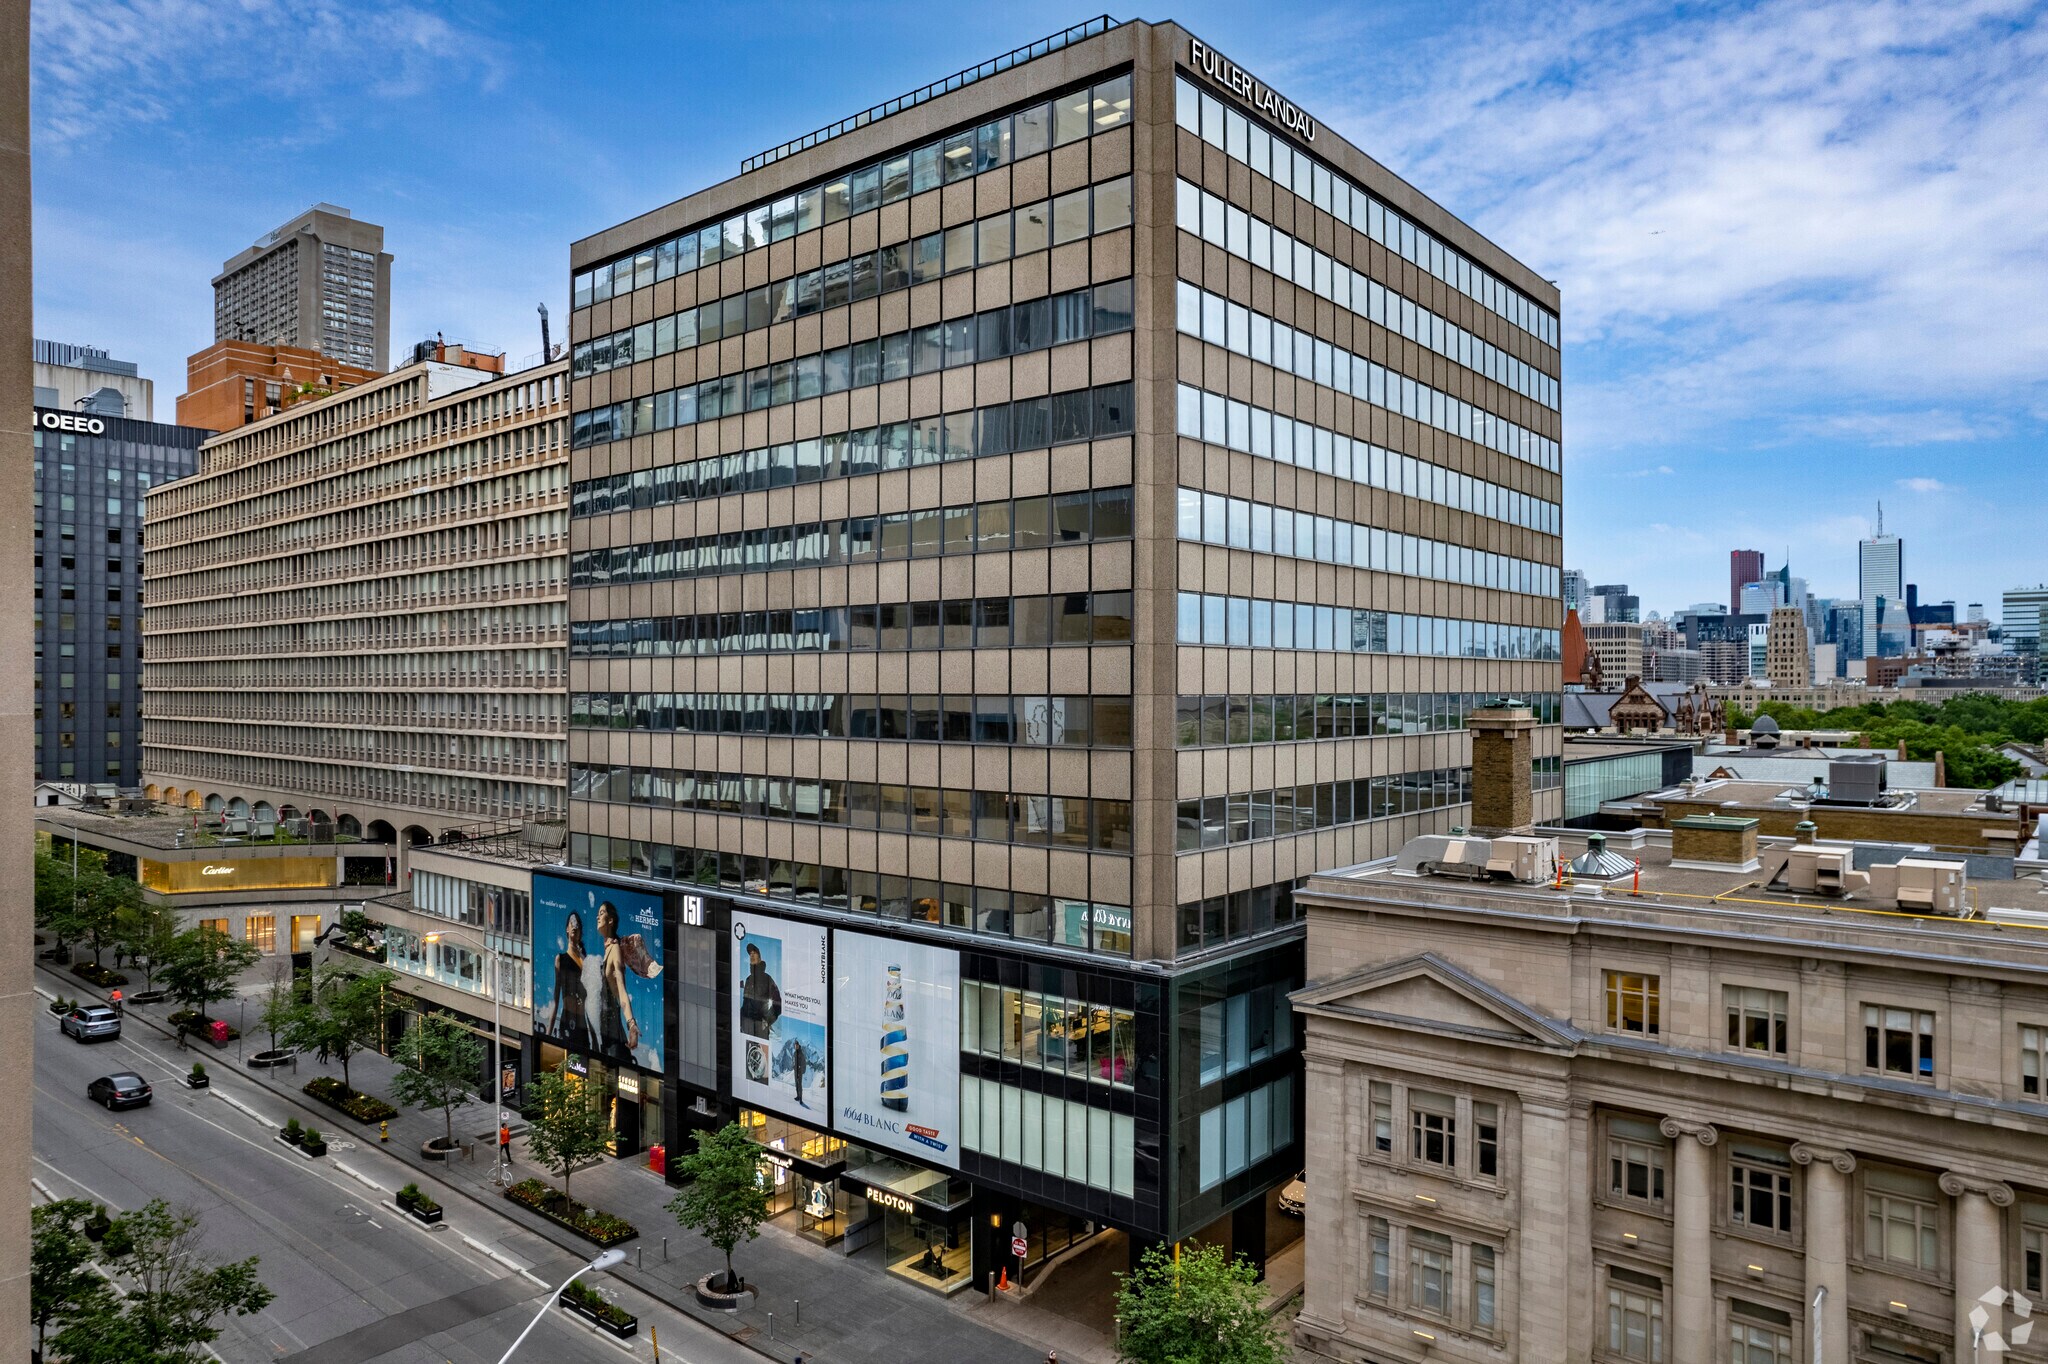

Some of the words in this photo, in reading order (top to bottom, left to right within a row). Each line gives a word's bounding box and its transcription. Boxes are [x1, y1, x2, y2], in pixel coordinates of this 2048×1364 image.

[1190, 38, 1252, 101] FULLER
[1254, 80, 1316, 142] LANDAU
[202, 865, 235, 876] Cartier
[683, 895, 703, 926] 151
[784, 991, 797, 999] WHAT
[797, 995, 811, 1003] MOVES
[784, 999, 799, 1008] MAKES
[799, 1002, 809, 1010] YOU
[843, 1106, 862, 1124] 1664
[864, 1113, 900, 1135] BLANC
[908, 1125, 922, 1133] GOOD
[922, 1128, 936, 1136] TASTE
[866, 1187, 914, 1214] PELOTON
